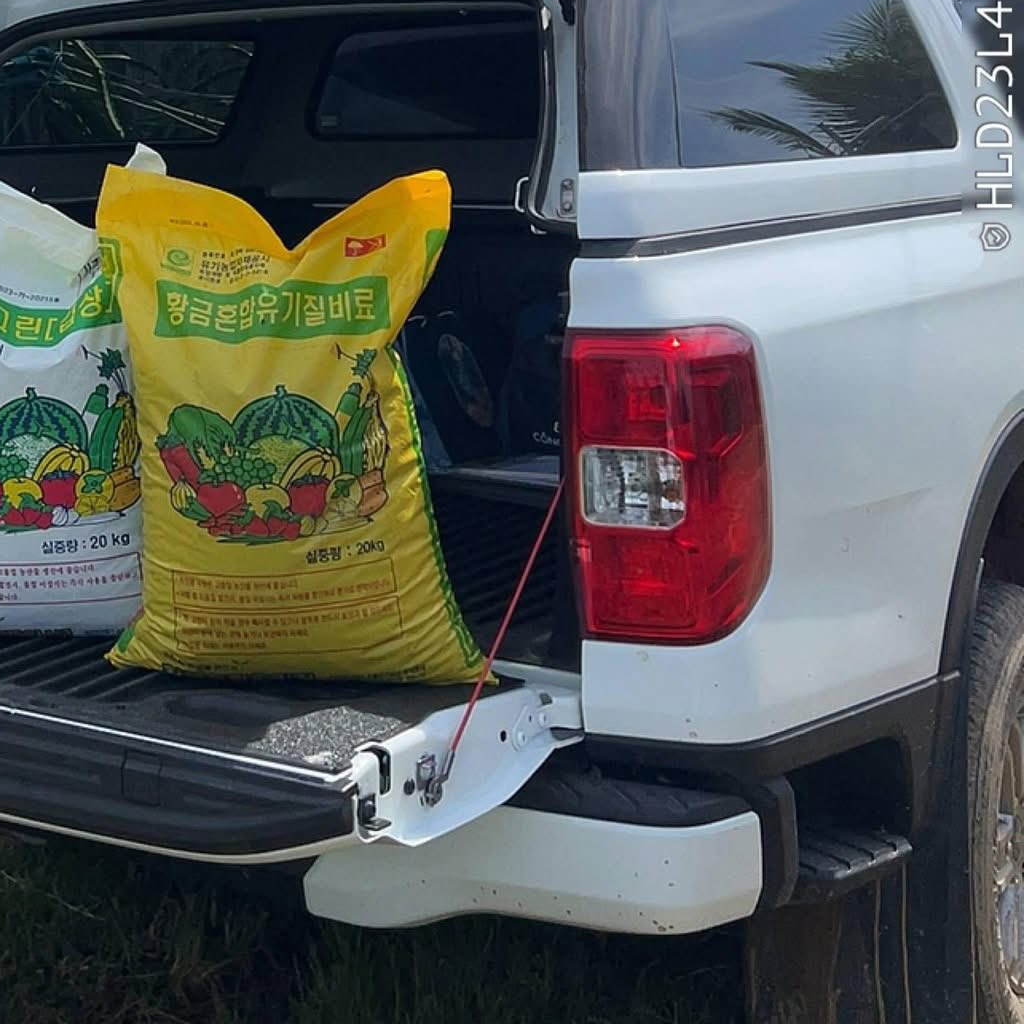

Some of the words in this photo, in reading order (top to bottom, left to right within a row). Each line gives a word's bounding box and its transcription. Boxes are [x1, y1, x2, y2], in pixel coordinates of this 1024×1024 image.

[166, 287, 377, 334] 황금혼합유기질비료
[89, 534, 108, 550] 20
[111, 532, 130, 546] kg
